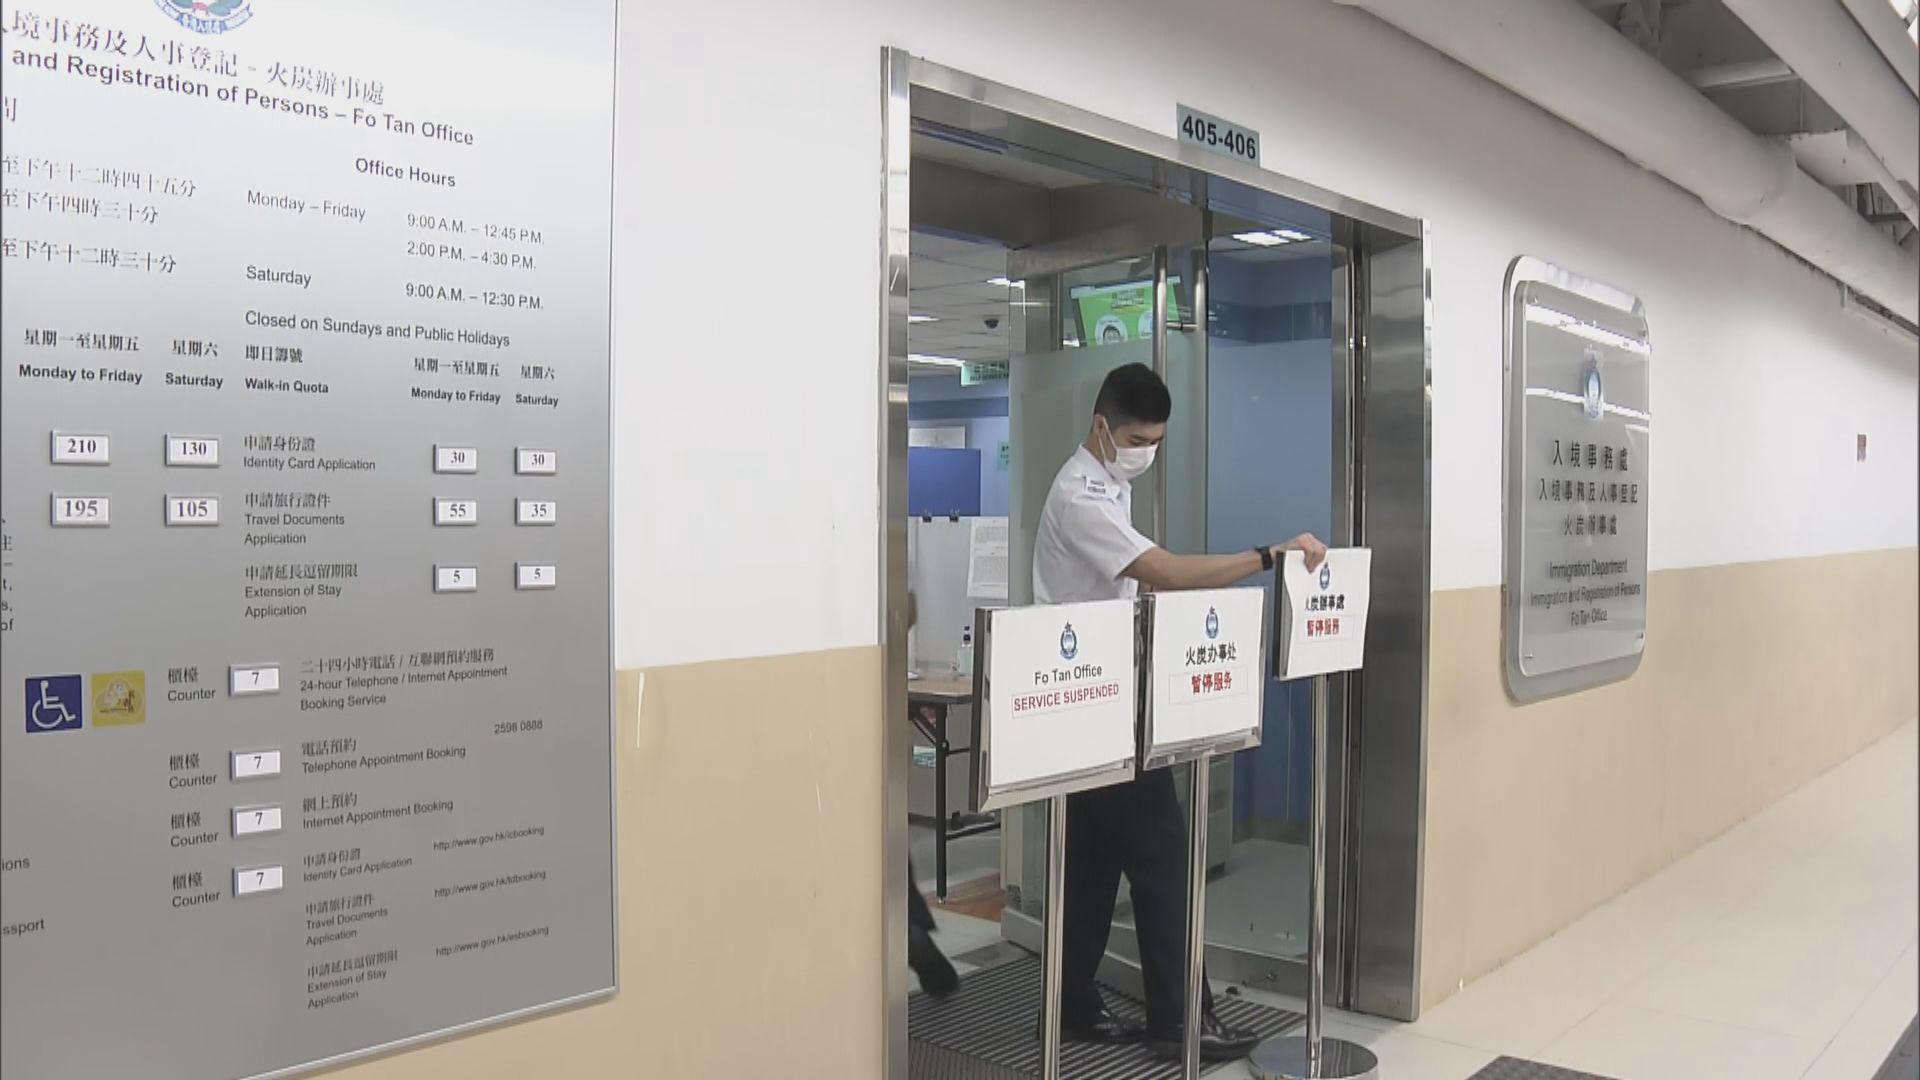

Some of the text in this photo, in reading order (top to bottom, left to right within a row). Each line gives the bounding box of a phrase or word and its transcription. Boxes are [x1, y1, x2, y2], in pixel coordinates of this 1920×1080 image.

[2, 10, 238, 77] 境事務及人事登記
[266, 60, 385, 106] 火炭辦事處
[12, 49, 58, 71] and
[66, 54, 210, 98] Registration
[216, 84, 239, 102] of
[244, 87, 329, 120] Persons
[352, 107, 377, 128] Fo
[384, 113, 416, 136] Tan
[421, 121, 474, 146] Office
[1182, 113, 1256, 160] 405-406
[355, 157, 456, 188] Office Hours
[2, 187, 159, 225] 至下午四時三十分
[246, 189, 306, 214] Monday
[322, 200, 367, 223] Friday
[407, 213, 436, 231] 9:00
[438, 217, 467, 235] A.M.
[484, 223, 517, 241] 12:45
[2, 237, 177, 274] 至下午十二時三十分
[407, 240, 436, 258] 2:00
[438, 245, 467, 262] P.M.
[480, 250, 509, 267] 4:30
[511, 254, 538, 271] P.M.
[245, 265, 312, 289] Saturday
[405, 282, 435, 300] 9:00
[436, 285, 466, 303] A.M.
[482, 291, 516, 308] 12:30
[518, 295, 545, 312] P.M.
[245, 309, 511, 348] Closed on Sundays and Public Holidays
[24, 327, 140, 352] 星期一至星期五
[172, 338, 219, 358] 星期六
[18, 363, 143, 386] Monday to Friday
[413, 356, 500, 378] 星期一至星期五
[520, 364, 556, 381] 星期六
[164, 371, 225, 390] Saturday
[245, 377, 329, 394] Walk-in Quota
[411, 386, 501, 405] Monday to Friday
[515, 393, 559, 408] Saturday
[67, 437, 97, 454] 210
[181, 441, 208, 456] 130
[243, 455, 376, 472] Identity Card Application
[450, 451, 466, 464] 30
[531, 453, 546, 466] 30
[64, 499, 99, 518] 195
[177, 500, 209, 518] 105
[449, 503, 467, 518] 55
[531, 503, 548, 518] 35
[244, 513, 346, 526] Travel Documents
[244, 532, 307, 547] Application
[453, 570, 461, 584] 5
[534, 568, 542, 580] 5
[1548, 558, 1628, 583] Immigration Department
[245, 583, 343, 599] Extension of Stay
[1530, 591, 1568, 609] Immigration
[1568, 588, 1581, 604] and
[244, 605, 308, 619] Application
[1570, 611, 1580, 626] Fo
[1591, 607, 1608, 623] Office
[1185, 641, 1237, 667] 火炭办事处
[251, 671, 260, 685] 7
[300, 679, 342, 692] 24-hour
[345, 674, 399, 690] Telephone
[408, 671, 446, 684] Internet
[448, 666, 508, 682] Appointment
[1034, 663, 1103, 686] Fo Tan Office
[167, 687, 216, 702] Counter
[300, 693, 387, 711] Booking Service
[1013, 682, 1119, 712] SERVICE SUSPENDED
[254, 755, 262, 769] 7
[302, 746, 466, 774] Telephone Appointment Booking
[168, 773, 217, 789] Counter
[255, 811, 263, 825] 7
[303, 799, 454, 830] Internet Appointment Booking
[170, 831, 219, 848] Counter
[256, 871, 264, 886] 7
[303, 856, 413, 883] Identity Card Application
[171, 891, 221, 908] Counter
[306, 907, 389, 931] Travel Documents
[306, 928, 357, 947] Application
[307, 969, 387, 994] Extension of Stay
[308, 990, 359, 1009] Application
